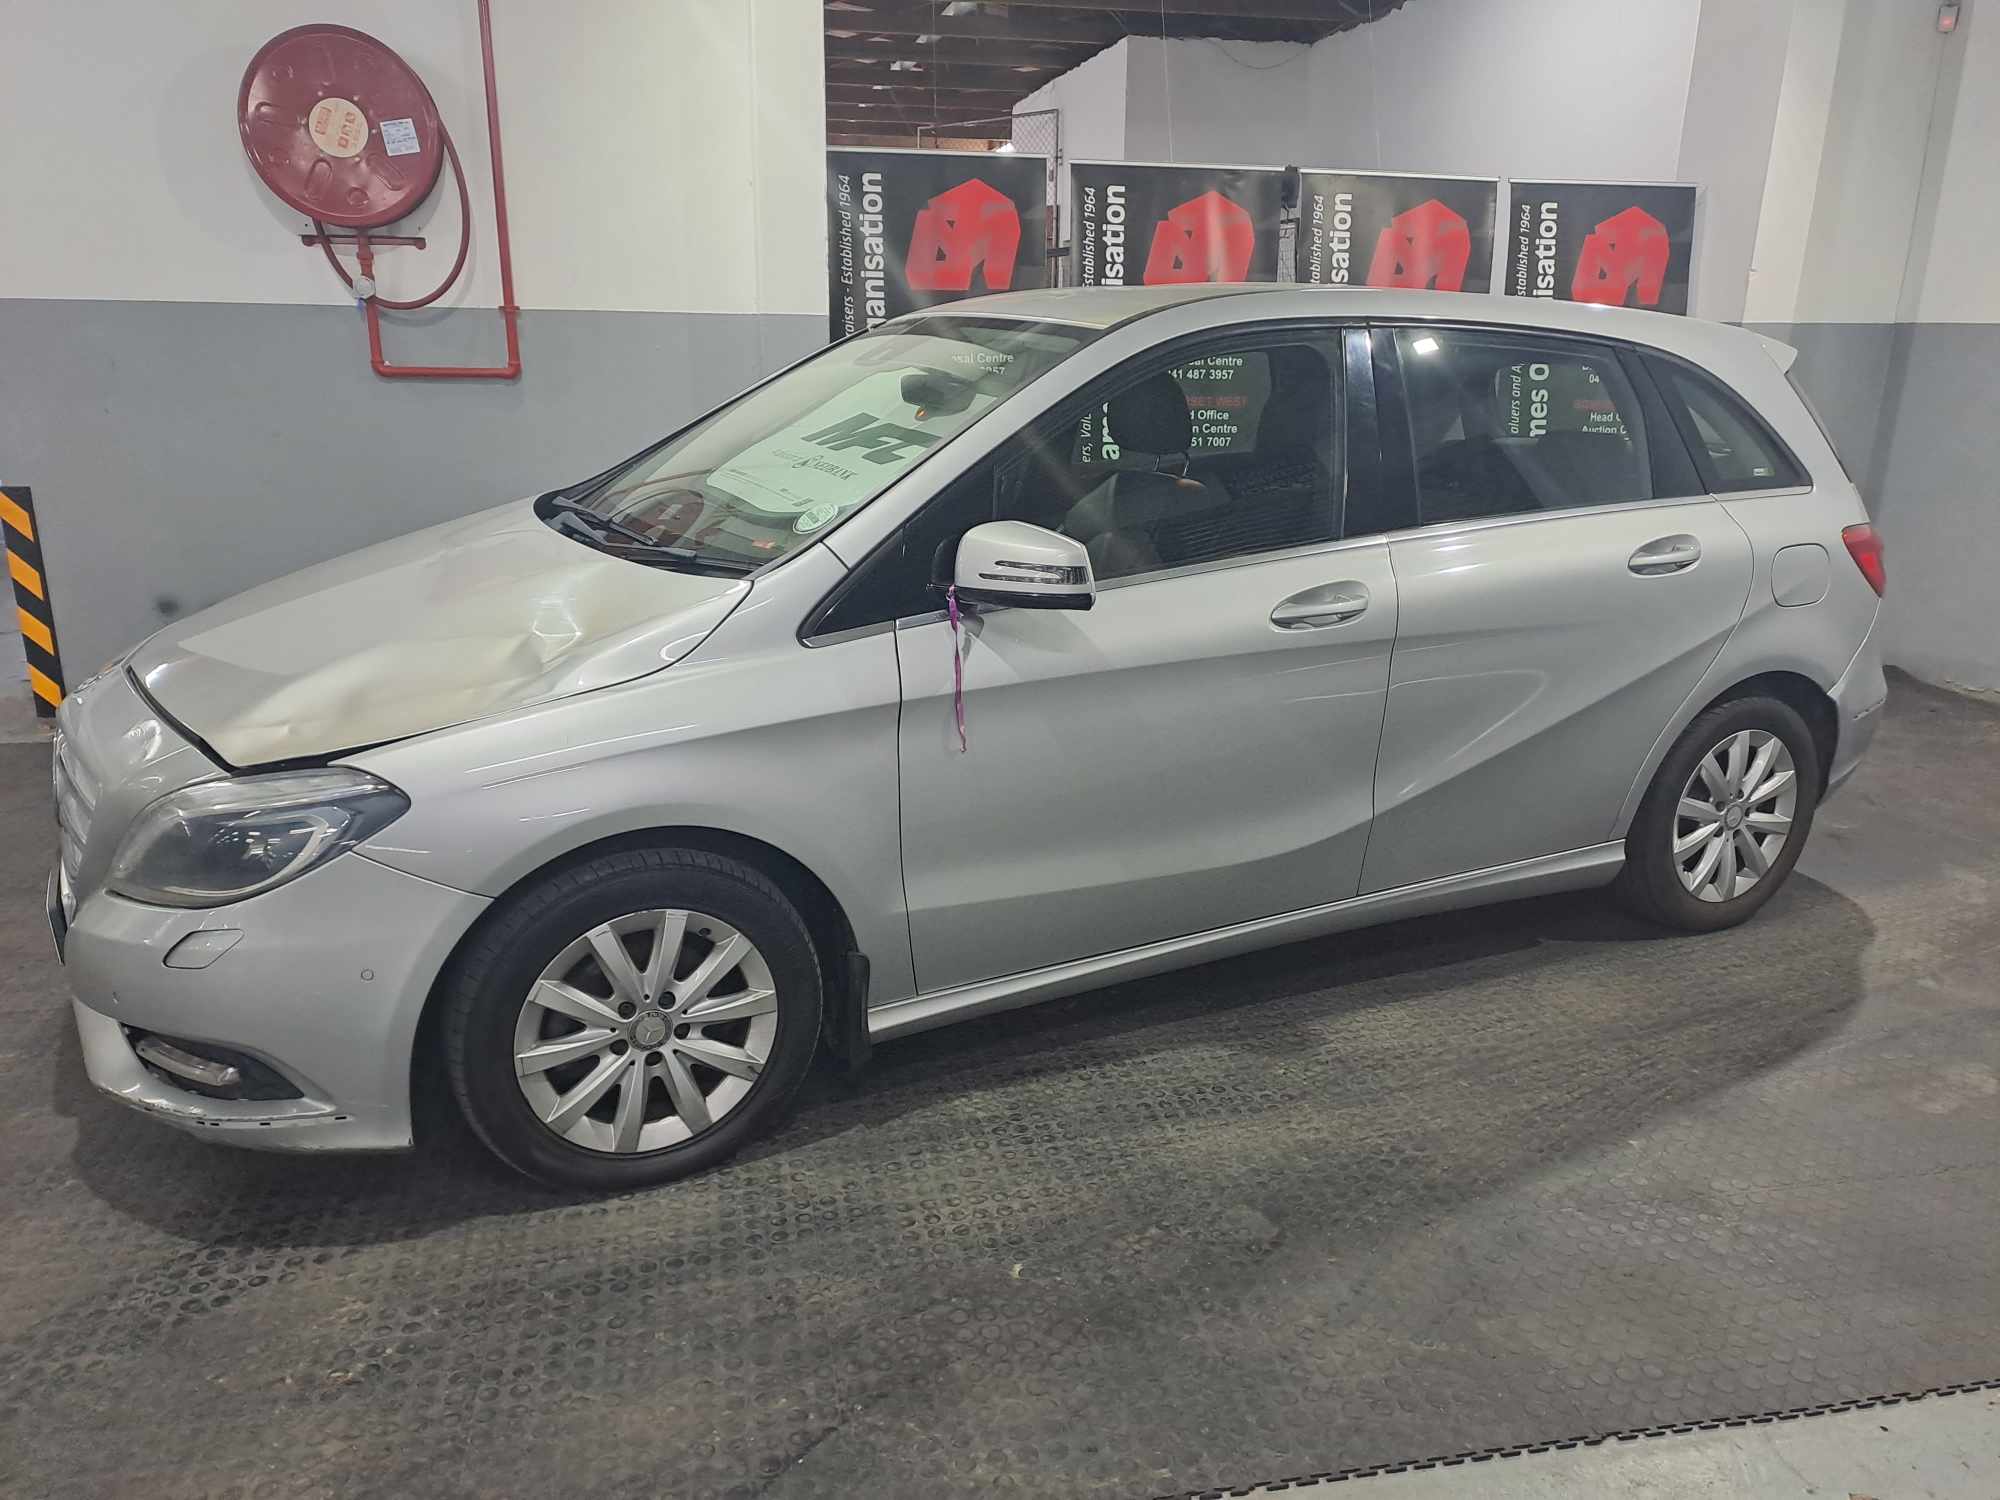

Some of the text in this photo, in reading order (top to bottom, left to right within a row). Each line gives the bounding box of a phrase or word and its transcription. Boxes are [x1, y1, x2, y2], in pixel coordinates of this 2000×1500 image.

[838, 174, 850, 205] 1964
[1083, 187, 1096, 217] 1964
[1313, 195, 1324, 224] 1964
[840, 210, 853, 285] Established
[1101, 185, 1125, 286] isation
[1329, 193, 1353, 283] sation
[1516, 204, 1531, 296] stablished 1964
[1532, 202, 1558, 297] isation
[976, 352, 1014, 363] Centre
[1207, 356, 1243, 366] Centre
[1187, 369, 1206, 380] 487
[1209, 369, 1234, 380] 3957
[1510, 375, 1521, 397] and
[1198, 409, 1229, 420] Office
[1202, 424, 1238, 434] Centre
[1508, 399, 1521, 434] aluers
[1590, 412, 1613, 422] Head
[1191, 437, 1231, 447] 51 7007
